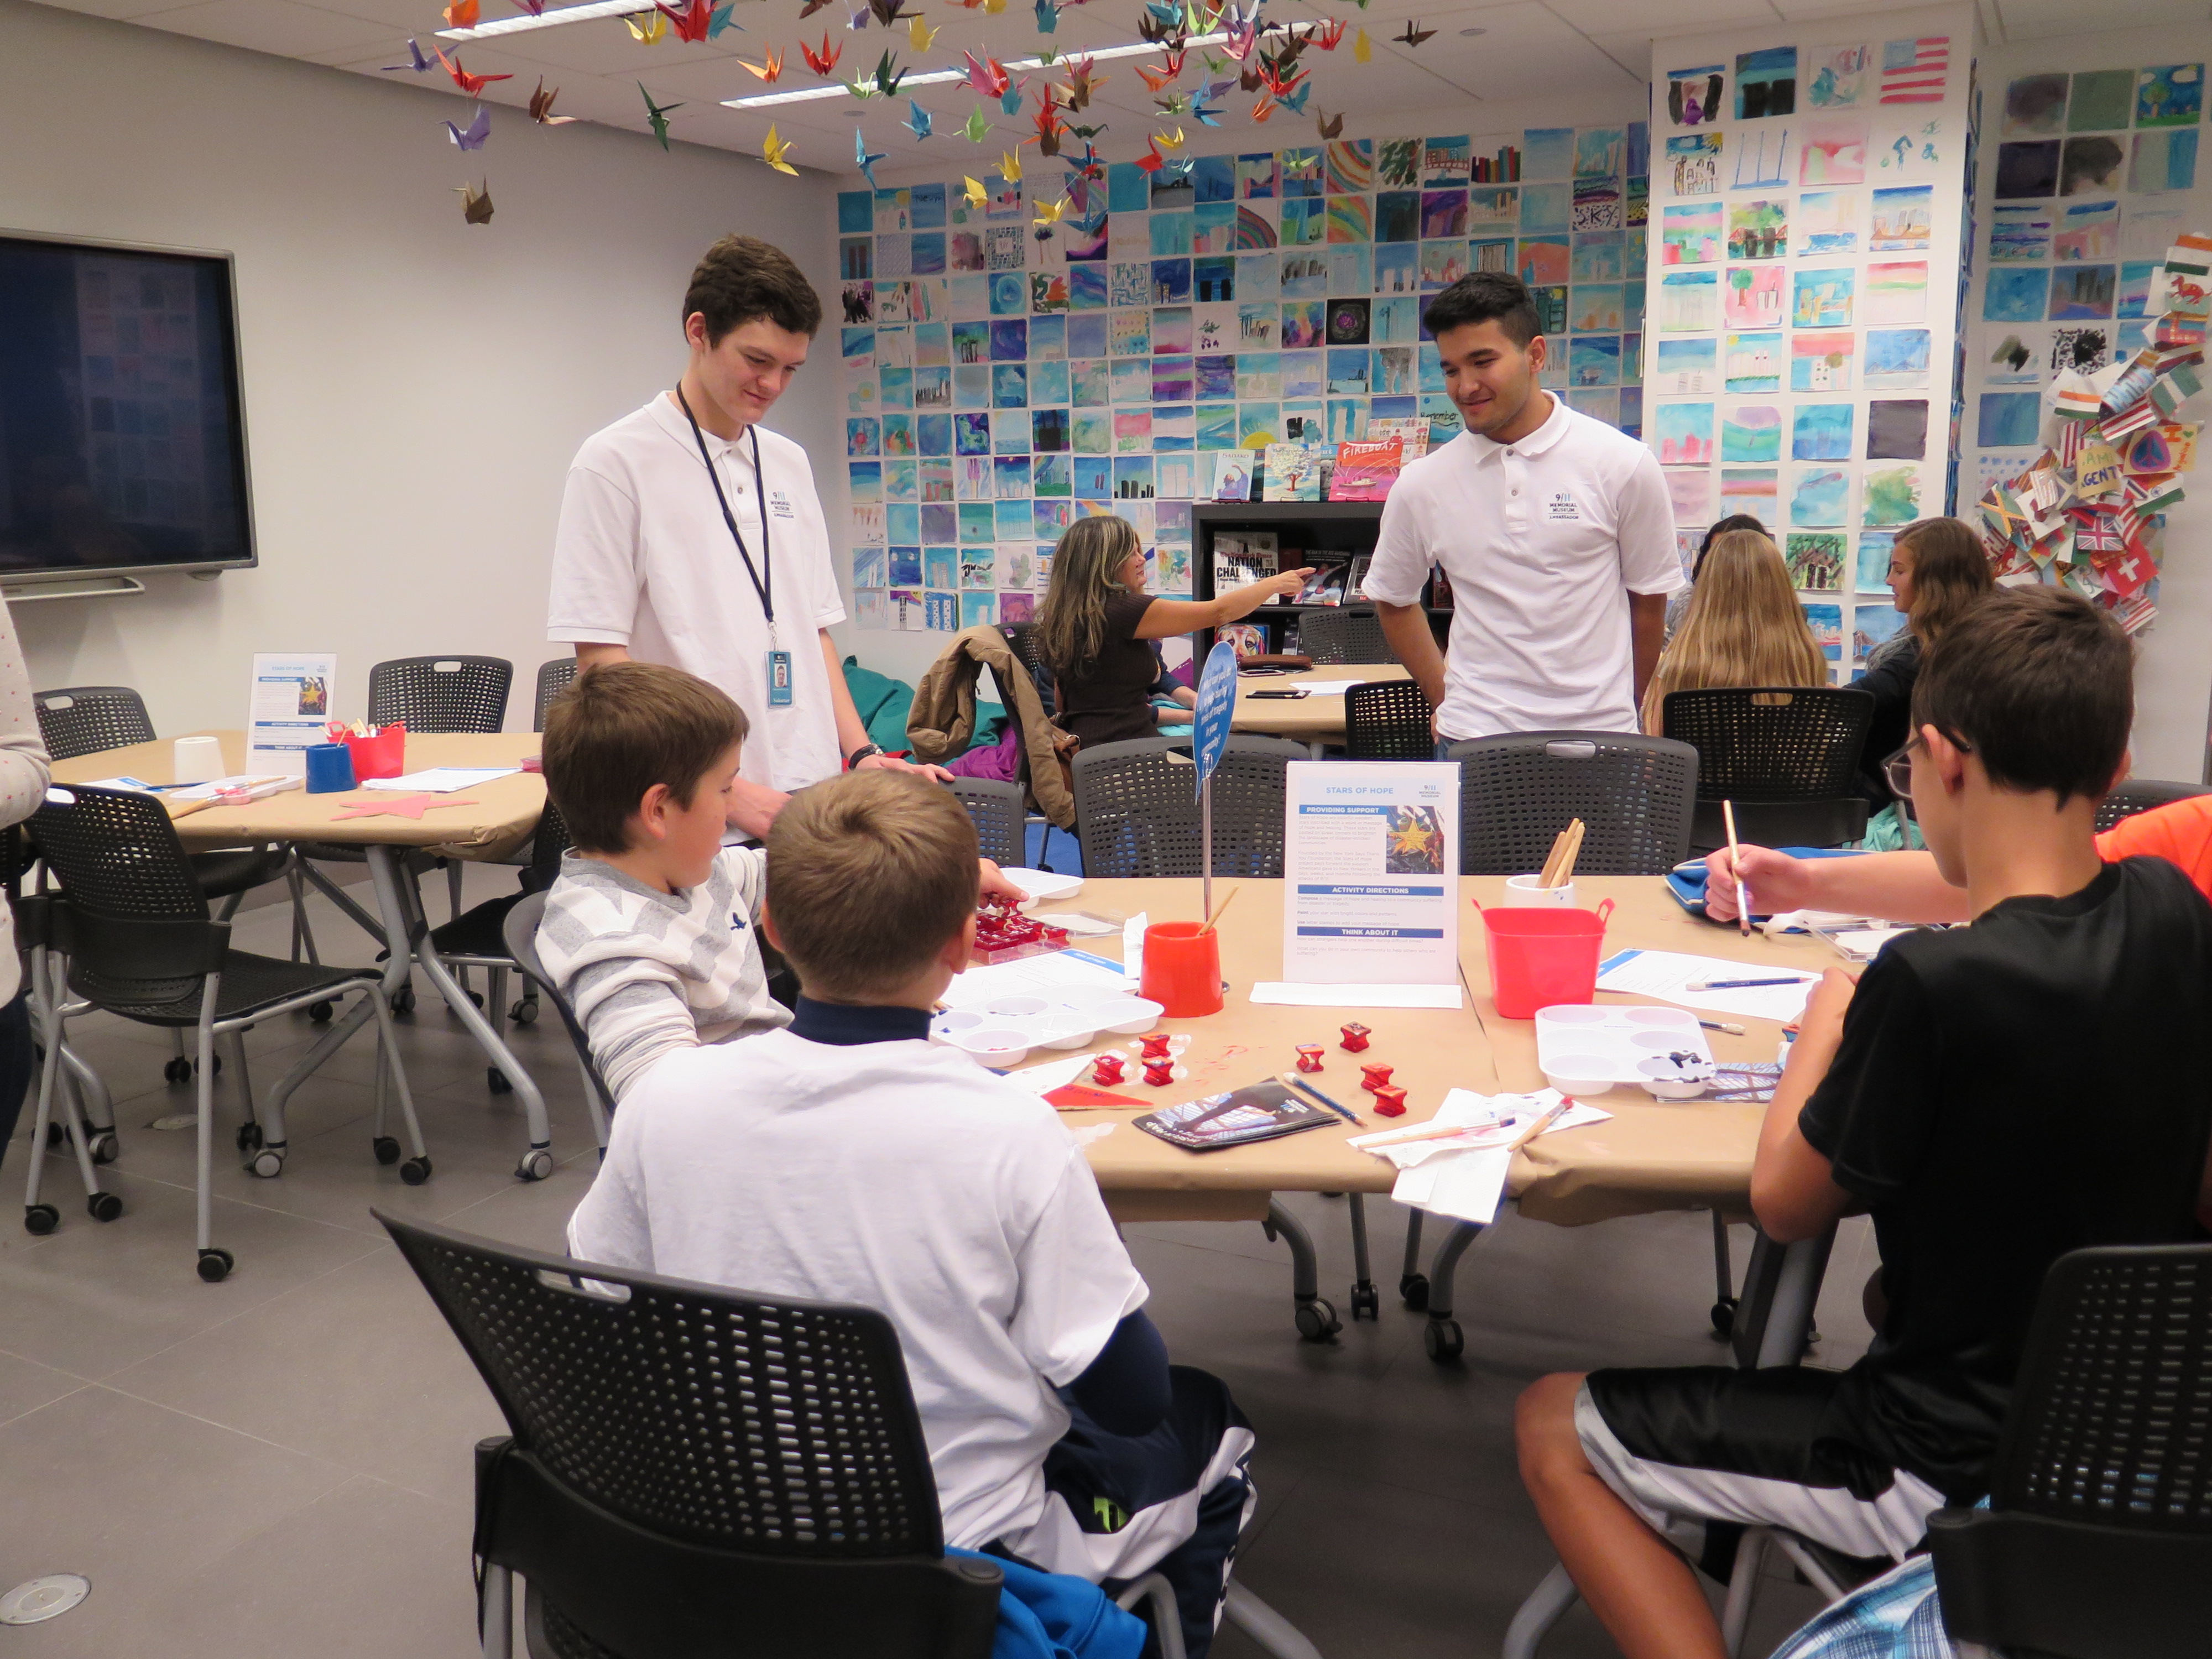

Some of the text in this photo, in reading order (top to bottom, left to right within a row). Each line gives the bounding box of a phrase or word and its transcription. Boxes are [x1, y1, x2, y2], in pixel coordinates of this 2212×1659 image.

[1577, 206, 1619, 227] SKY
[1555, 492, 1571, 502] 9/11
[1228, 556, 1263, 567] NATION
